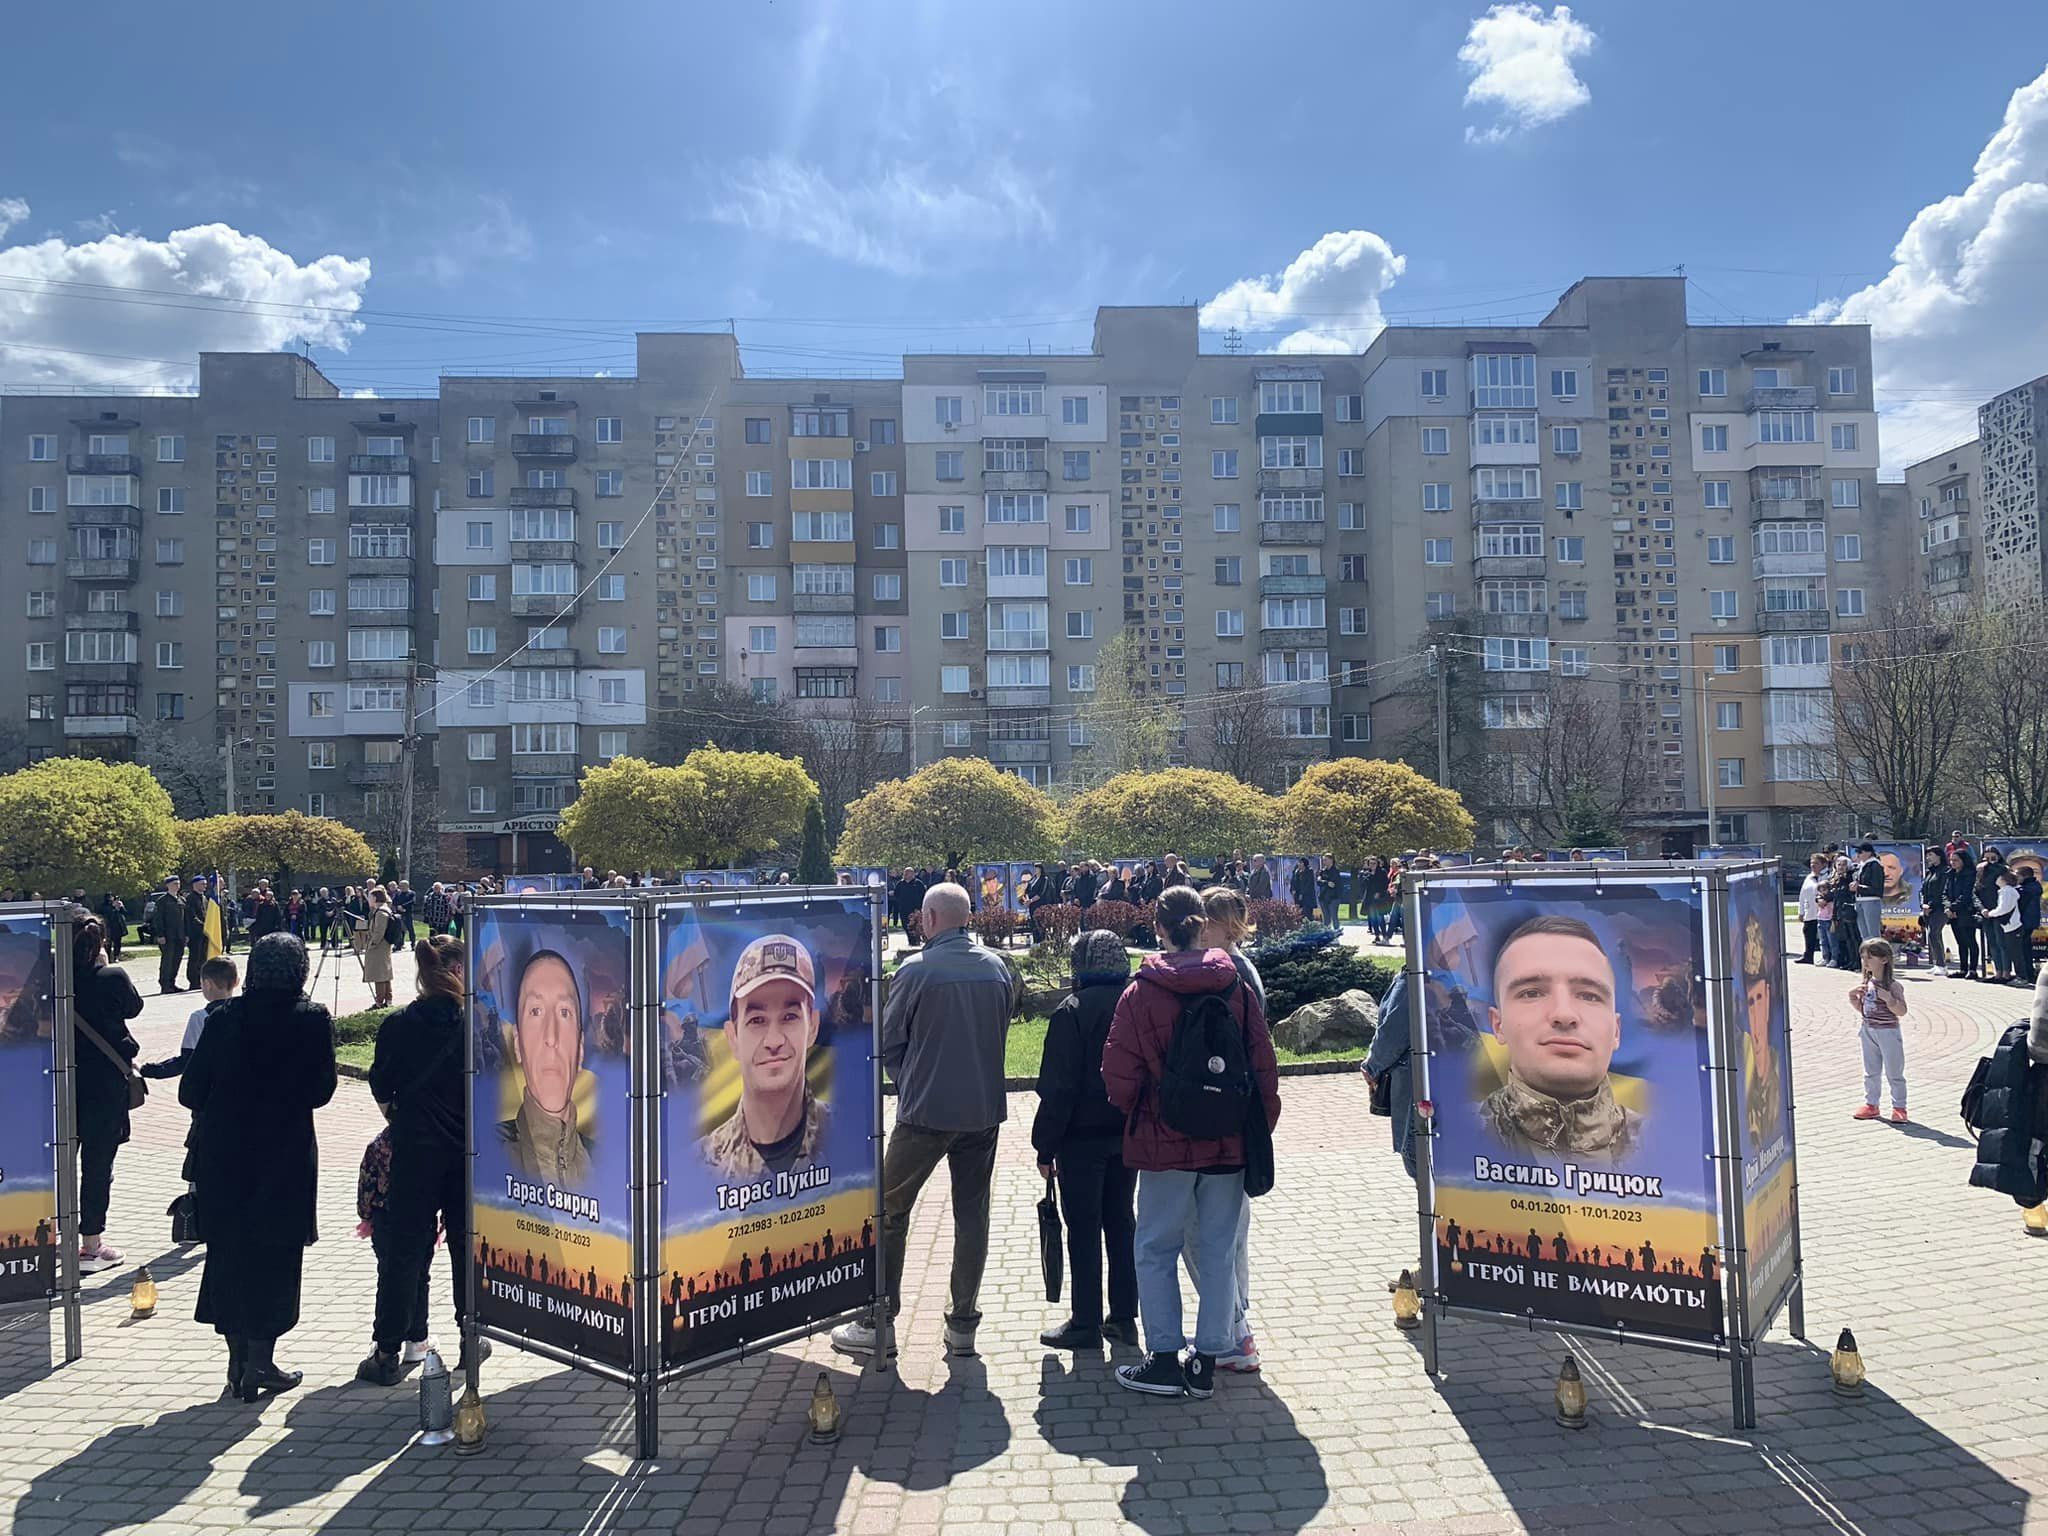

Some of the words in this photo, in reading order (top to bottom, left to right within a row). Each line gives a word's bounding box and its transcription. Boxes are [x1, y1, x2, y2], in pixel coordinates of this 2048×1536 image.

[505, 1174, 544, 1206] Тарас
[547, 1184, 599, 1222] Свирид
[716, 1179, 772, 1210] Тарас
[776, 1164, 830, 1199] Пукіш
[1475, 1156, 1559, 1187] Василь
[1564, 1164, 1662, 1197] Грицюк
[728, 1218, 773, 1239] 27.12.1983
[779, 1204, 826, 1225] 12.02.2023
[1510, 1198, 1572, 1215] 04.01.2001
[1581, 1206, 1642, 1223] 17.01.2023
[555, 1228, 591, 1247] 21.01.2023
[491, 1280, 524, 1304] ГЕРОЇ
[528, 1291, 542, 1310] НЕ
[547, 1296, 625, 1336] ВМИРАЮТЬ!
[689, 1296, 737, 1328] ГЕРОЇ
[744, 1291, 764, 1311] НЕ
[771, 1259, 865, 1303] ВМИРАЮТЬ!
[1467, 1262, 1525, 1285] ГЕРОЇ
[1534, 1271, 1558, 1289] НЕ
[1568, 1275, 1706, 1309] ВМИРАЮТЬ!
